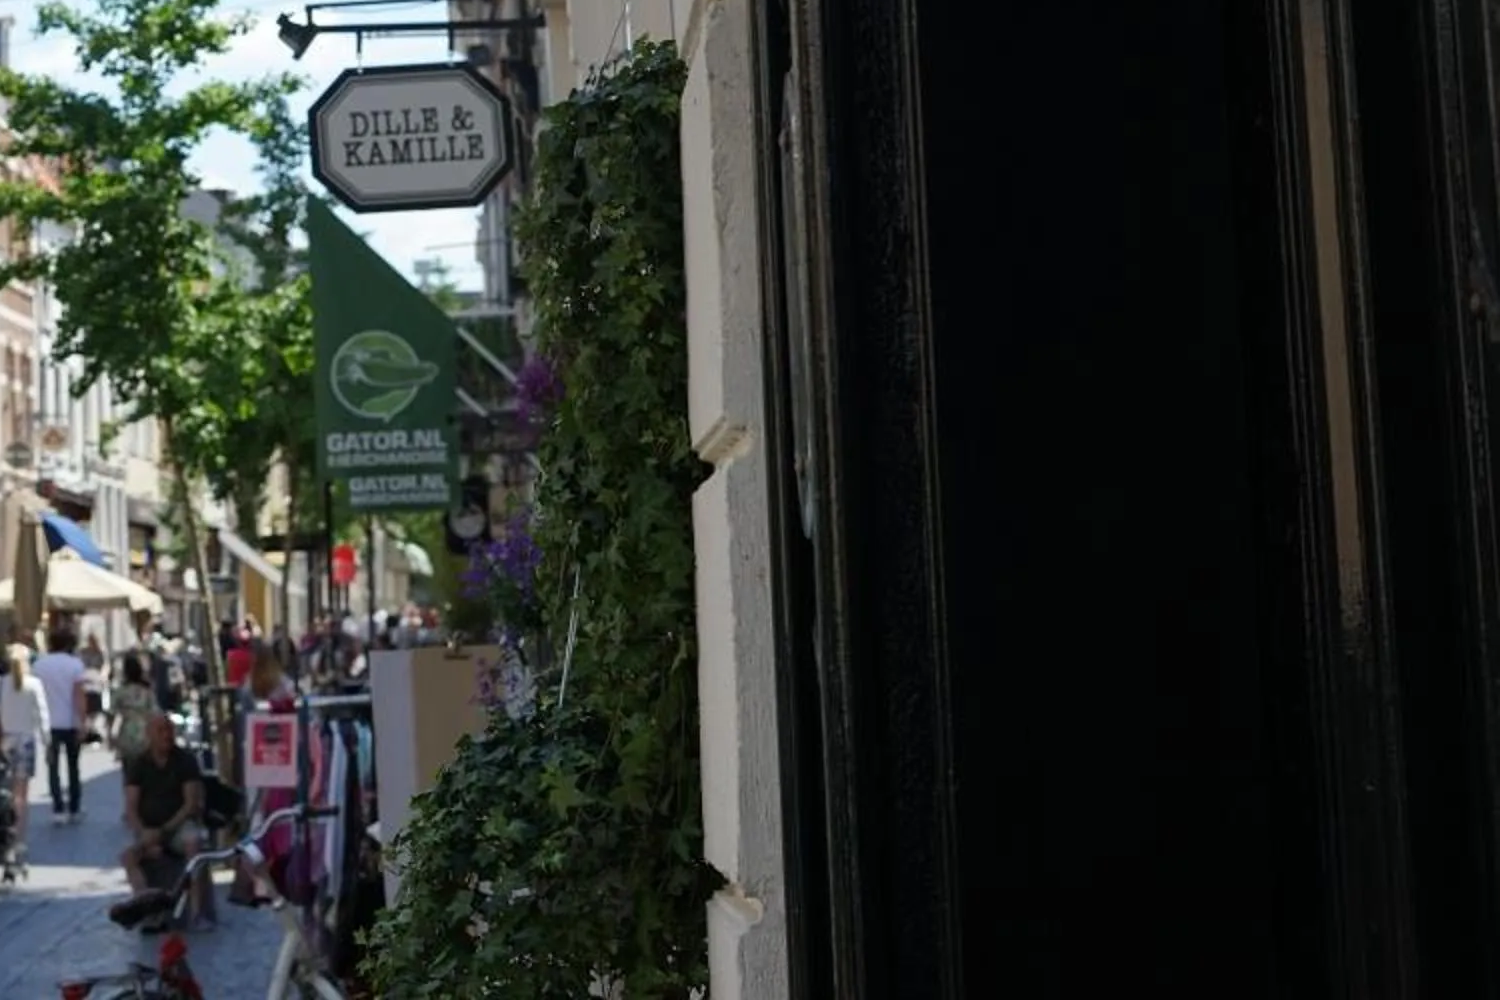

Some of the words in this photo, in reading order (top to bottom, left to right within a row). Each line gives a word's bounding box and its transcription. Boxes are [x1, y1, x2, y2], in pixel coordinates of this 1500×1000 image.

[349, 107, 439, 138] DILLE
[451, 104, 475, 132] &
[343, 133, 484, 167] KAMILLE
[326, 429, 449, 453] GATOR.NL
[349, 473, 449, 492] GATOR.NL
